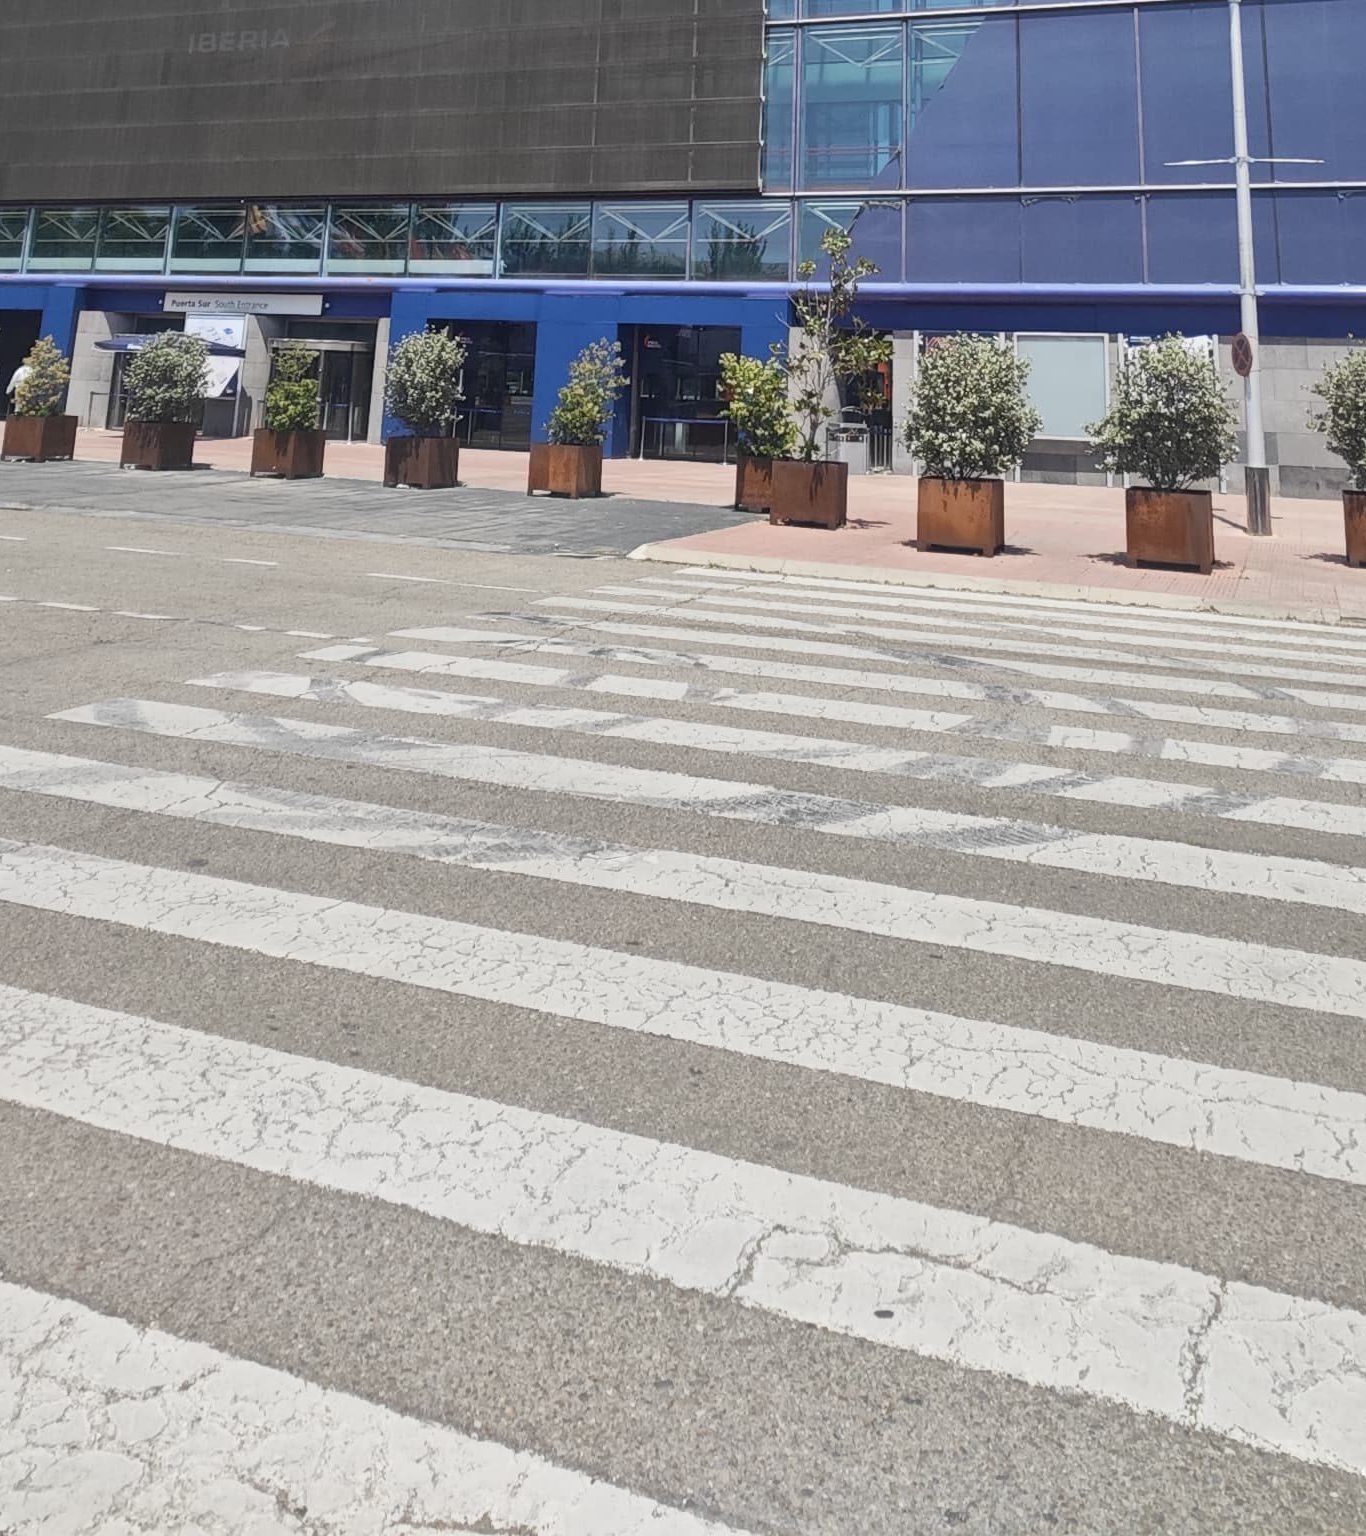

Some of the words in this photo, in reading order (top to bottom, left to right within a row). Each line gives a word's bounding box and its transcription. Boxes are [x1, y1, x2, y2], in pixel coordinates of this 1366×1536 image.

[187, 28, 290, 55] IBERIA
[171, 298, 196, 308] Puerta
[198, 299, 211, 308] Sur
[215, 299, 237, 309] South
[237, 300, 269, 310] Entrance
